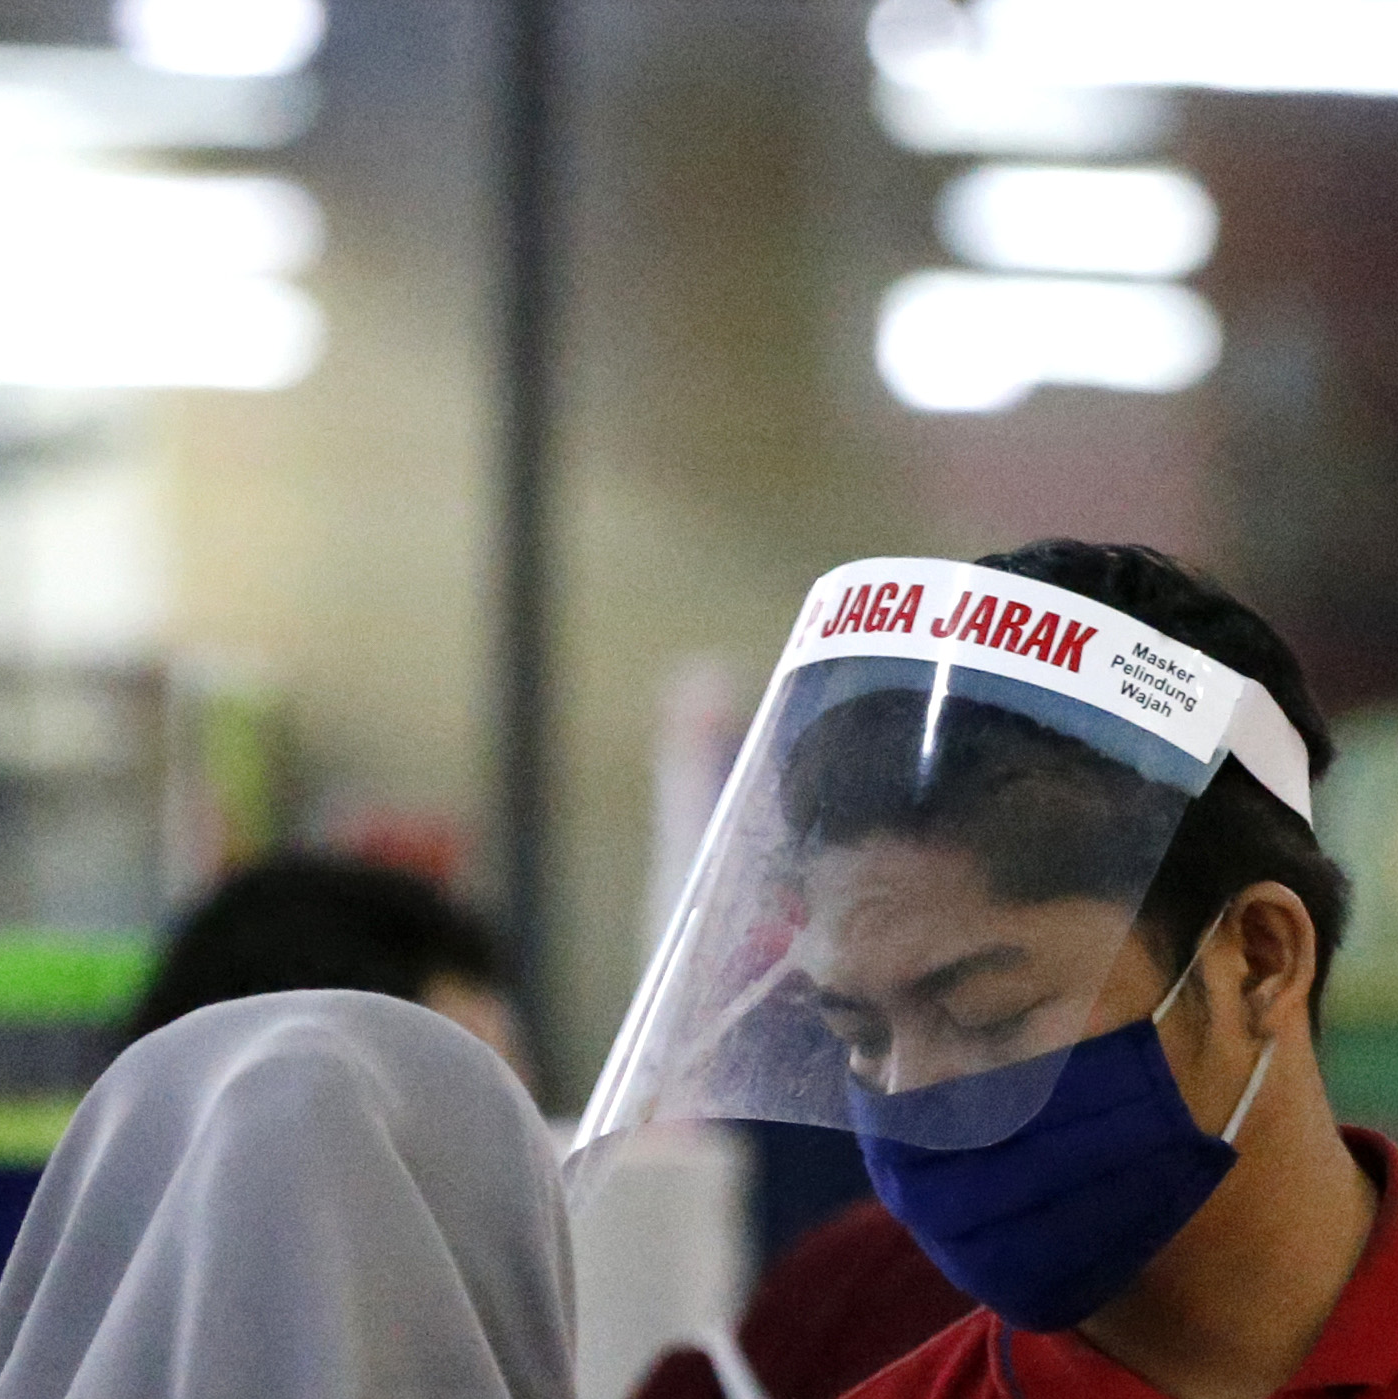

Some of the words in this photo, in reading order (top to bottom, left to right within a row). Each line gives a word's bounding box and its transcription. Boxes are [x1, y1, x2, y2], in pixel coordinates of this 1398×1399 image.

[822, 582, 925, 638] JAGA
[930, 591, 1099, 673] JARAK
[1110, 654, 1198, 712] Pelindung
[1132, 642, 1195, 684] Masker
[1121, 680, 1172, 717] Wajah
